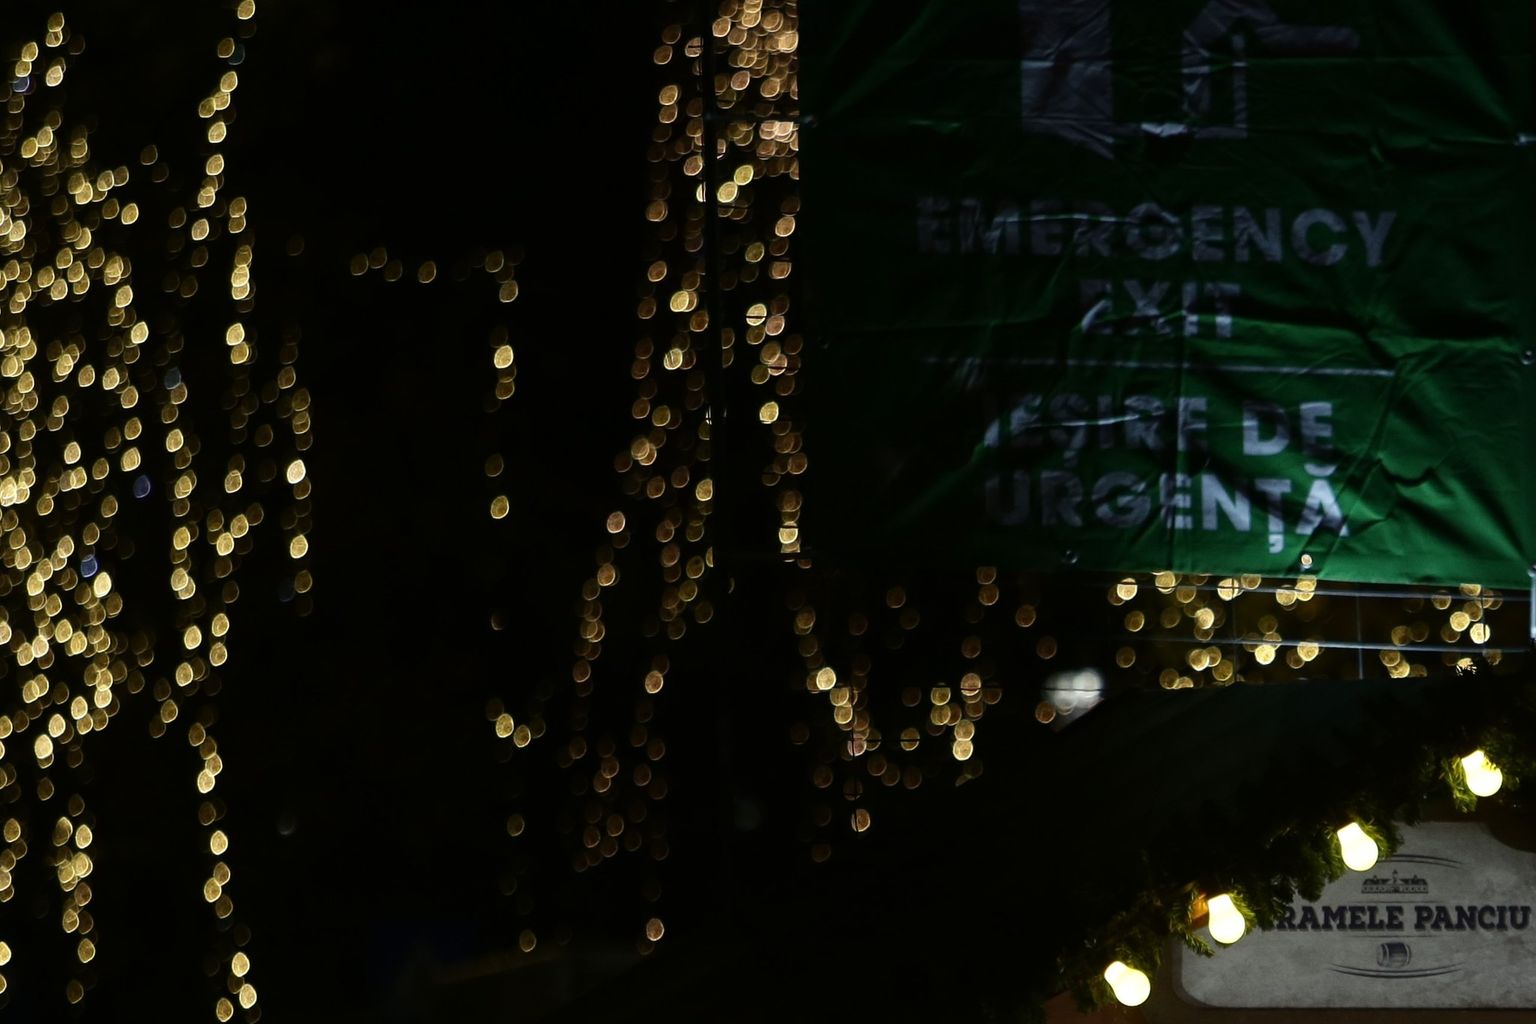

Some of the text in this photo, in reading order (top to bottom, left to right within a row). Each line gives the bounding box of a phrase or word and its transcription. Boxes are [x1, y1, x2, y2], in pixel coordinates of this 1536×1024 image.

[915, 198, 1397, 268] EMERGENCY
[1078, 277, 1242, 339] EXIT
[1242, 400, 1335, 457] DE
[1274, 905, 1532, 931] RAMELE PANCIU
